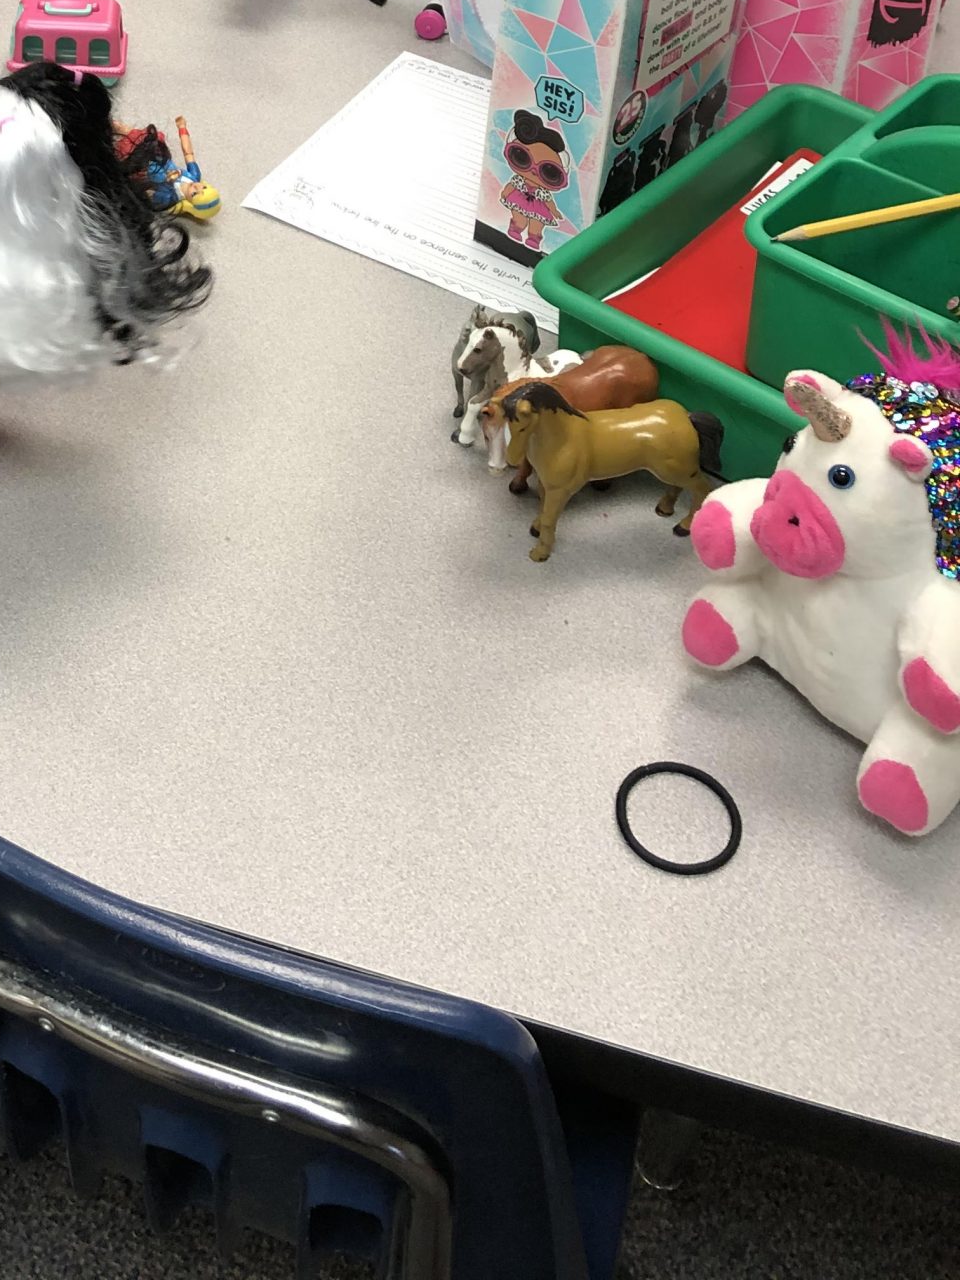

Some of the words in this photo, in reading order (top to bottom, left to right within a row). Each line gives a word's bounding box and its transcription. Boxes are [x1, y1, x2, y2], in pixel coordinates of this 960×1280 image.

[543, 95, 576, 117] SIS!
[383, 222, 400, 236] the
[402, 231, 419, 242] on
[419, 238, 470, 262] sentence
[471, 258, 488, 271] the
[492, 266, 521, 282] write
